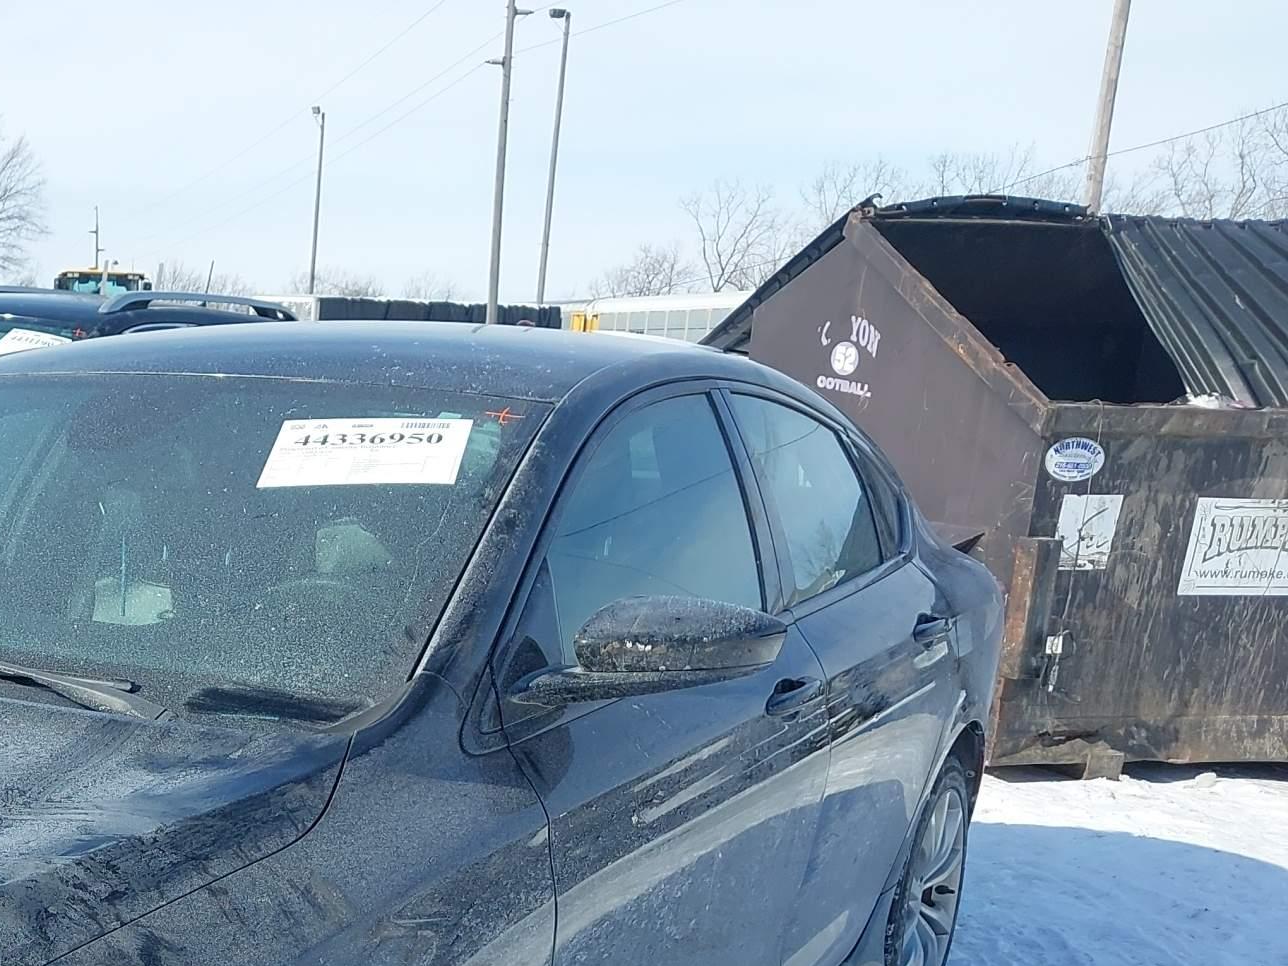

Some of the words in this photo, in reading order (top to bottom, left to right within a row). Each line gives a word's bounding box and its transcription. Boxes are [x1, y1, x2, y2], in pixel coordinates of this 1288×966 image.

[293, 432, 444, 446] 44336950
[1053, 440, 1102, 457] NORTHWEST
[1198, 567, 1288, 582] www.rumpke.
